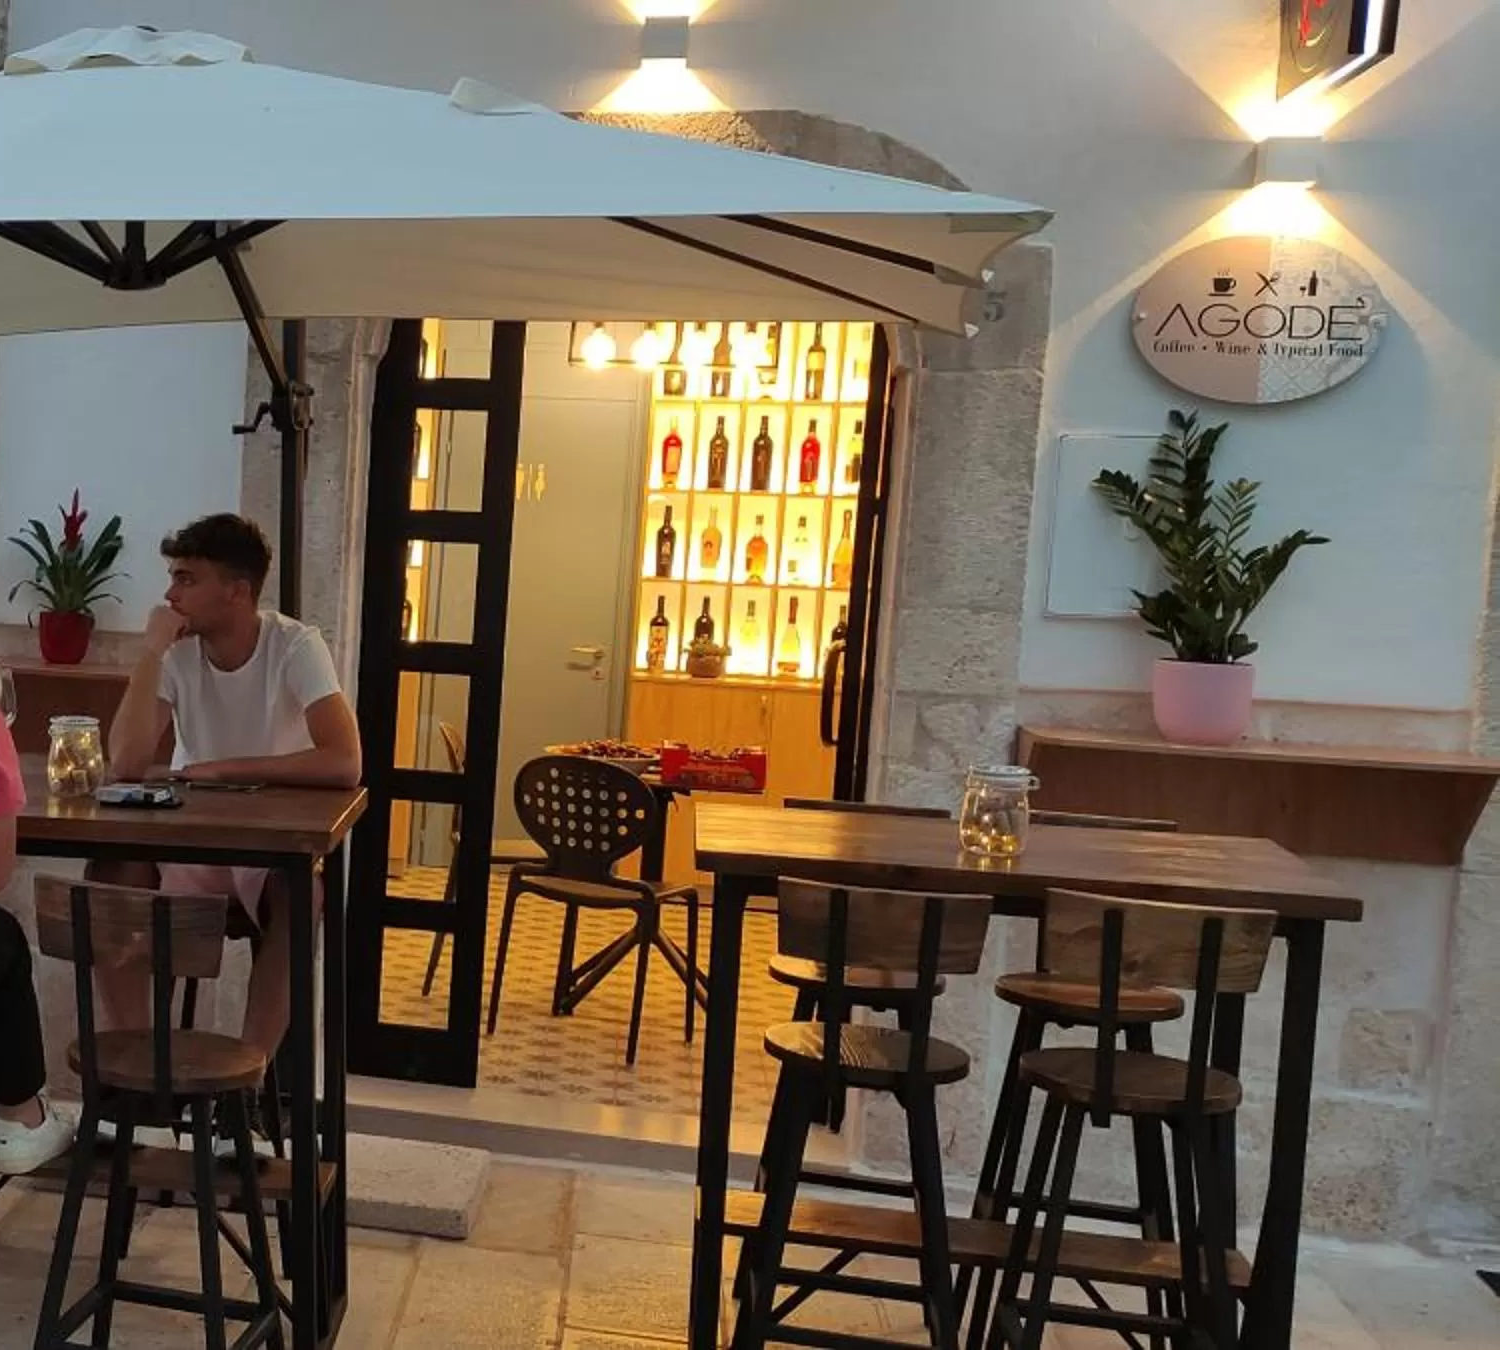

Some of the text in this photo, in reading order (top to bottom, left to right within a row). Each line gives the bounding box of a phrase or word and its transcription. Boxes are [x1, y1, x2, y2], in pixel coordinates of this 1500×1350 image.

[1152, 340, 1364, 359] Coffee Wine & Typical Food
